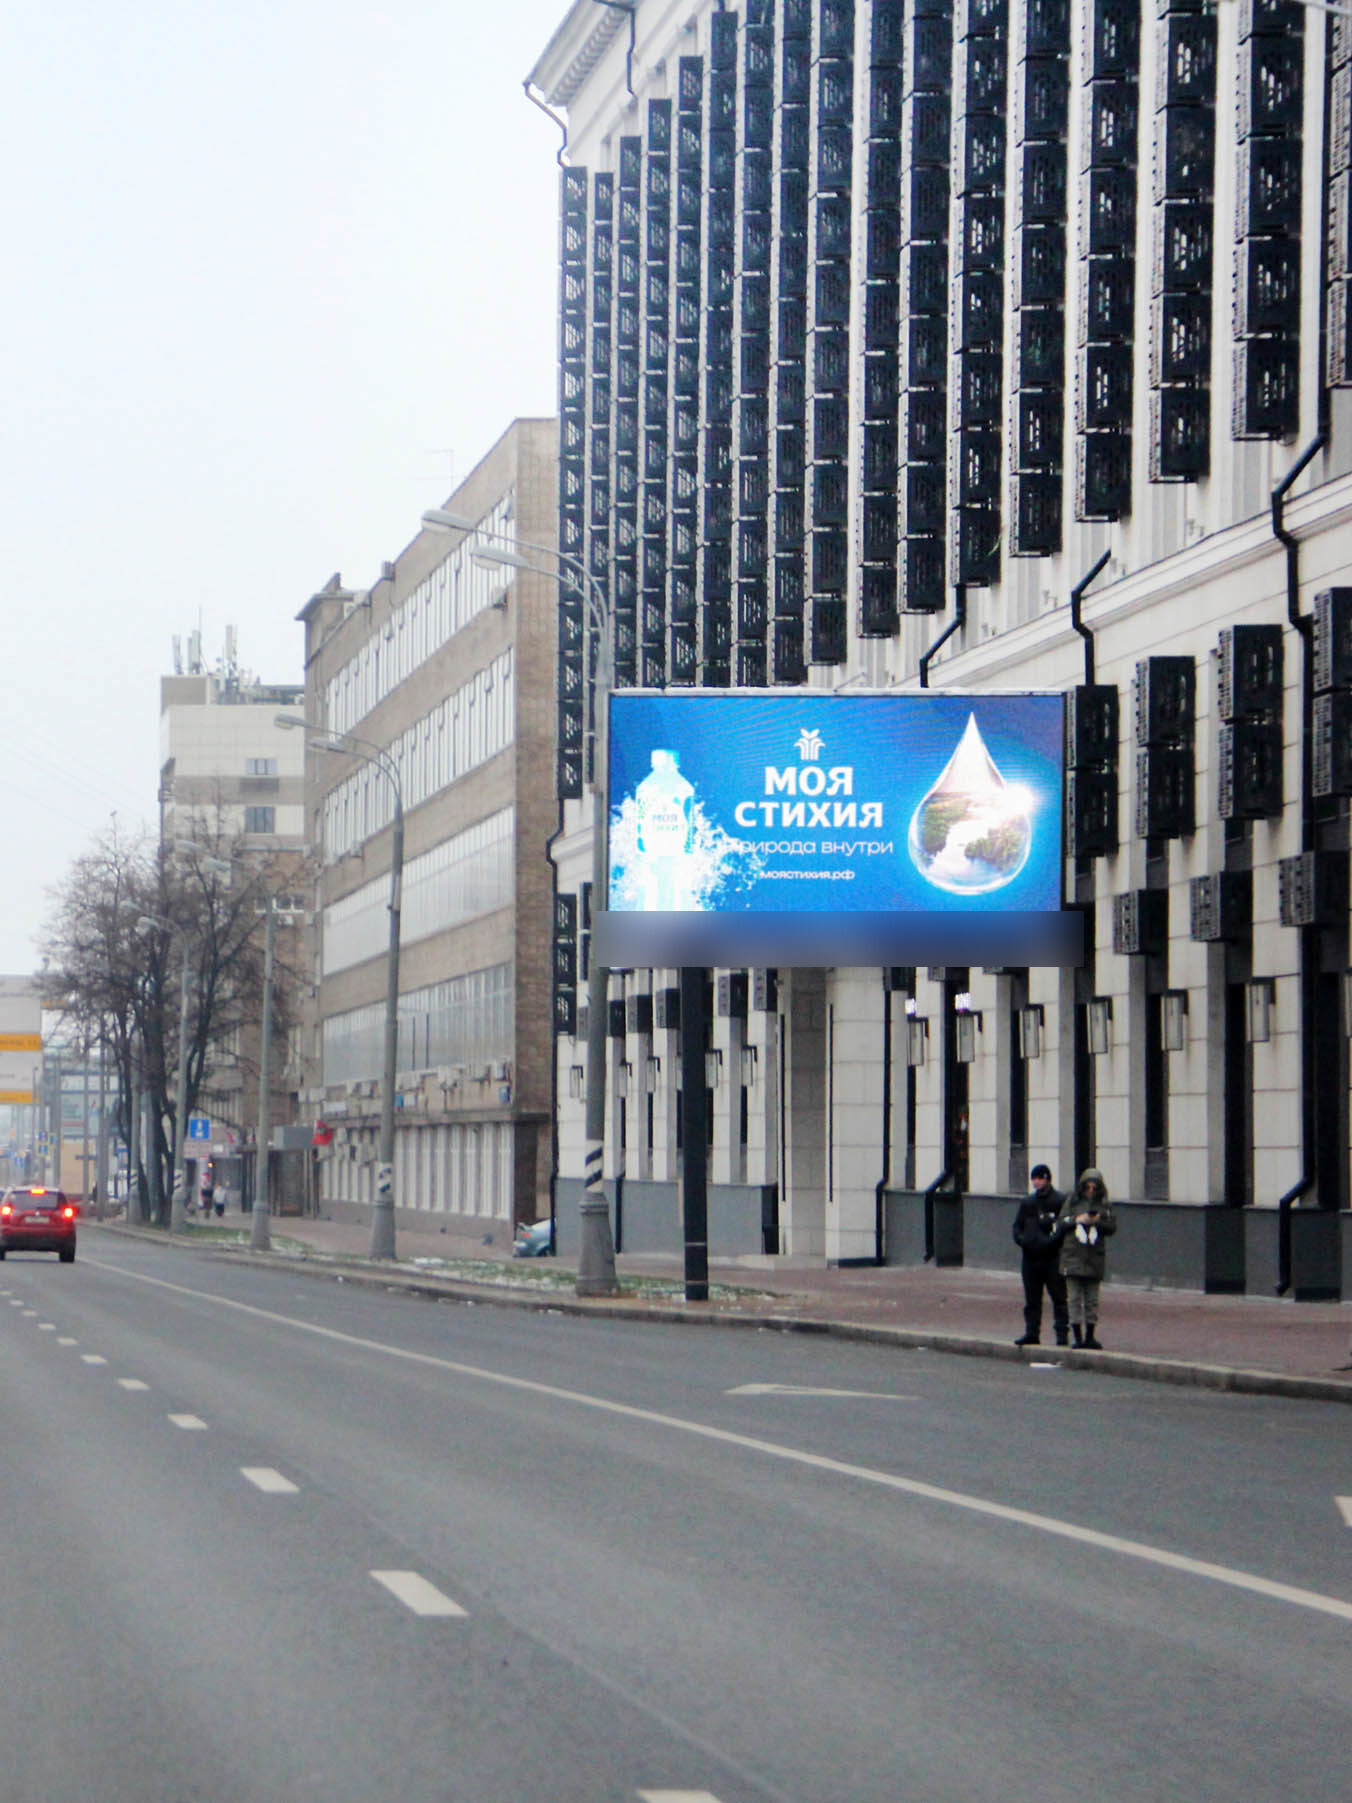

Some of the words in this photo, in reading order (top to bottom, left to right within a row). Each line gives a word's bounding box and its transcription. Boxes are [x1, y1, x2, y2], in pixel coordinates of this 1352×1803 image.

[765, 766, 853, 796] МОЯ
[734, 801, 883, 828] СТИХИЯ
[730, 841, 816, 855] рирода
[821, 841, 893, 857] внутри
